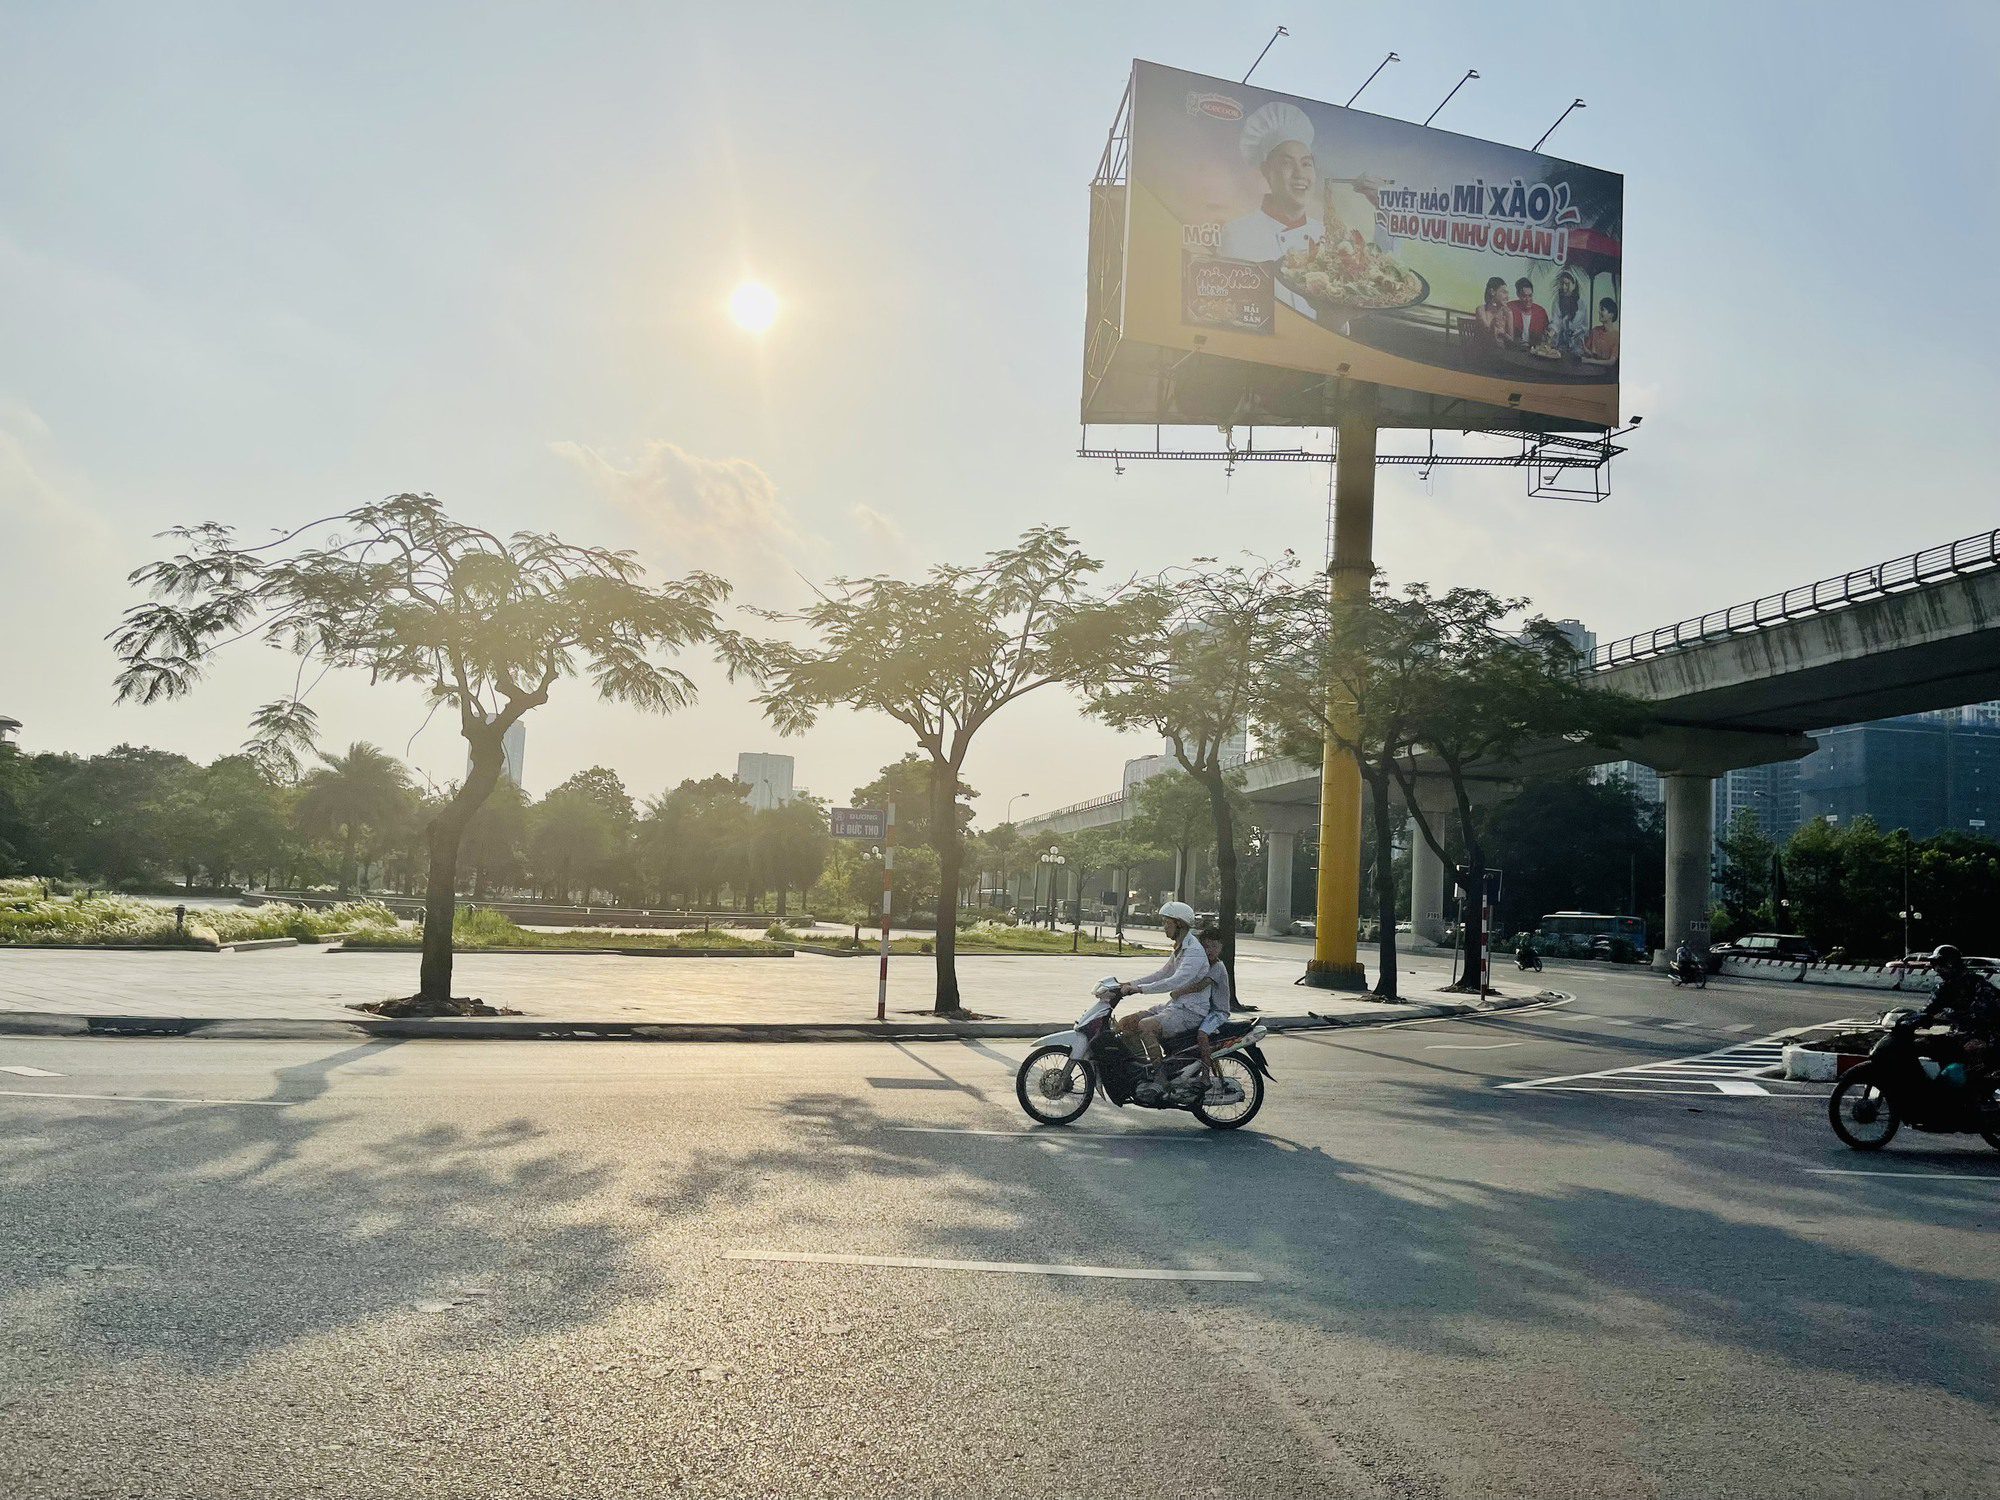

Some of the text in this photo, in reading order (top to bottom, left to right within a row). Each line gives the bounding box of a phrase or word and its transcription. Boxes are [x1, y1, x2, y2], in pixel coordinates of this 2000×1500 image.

[1379, 178, 1551, 221] TUYỆT HẢO MÌ XÀO
[1183, 223, 1220, 246] Mới
[1421, 217, 1447, 239] VUI
[1451, 221, 1491, 248] NHƯ
[1493, 223, 1552, 256] QUÁN
